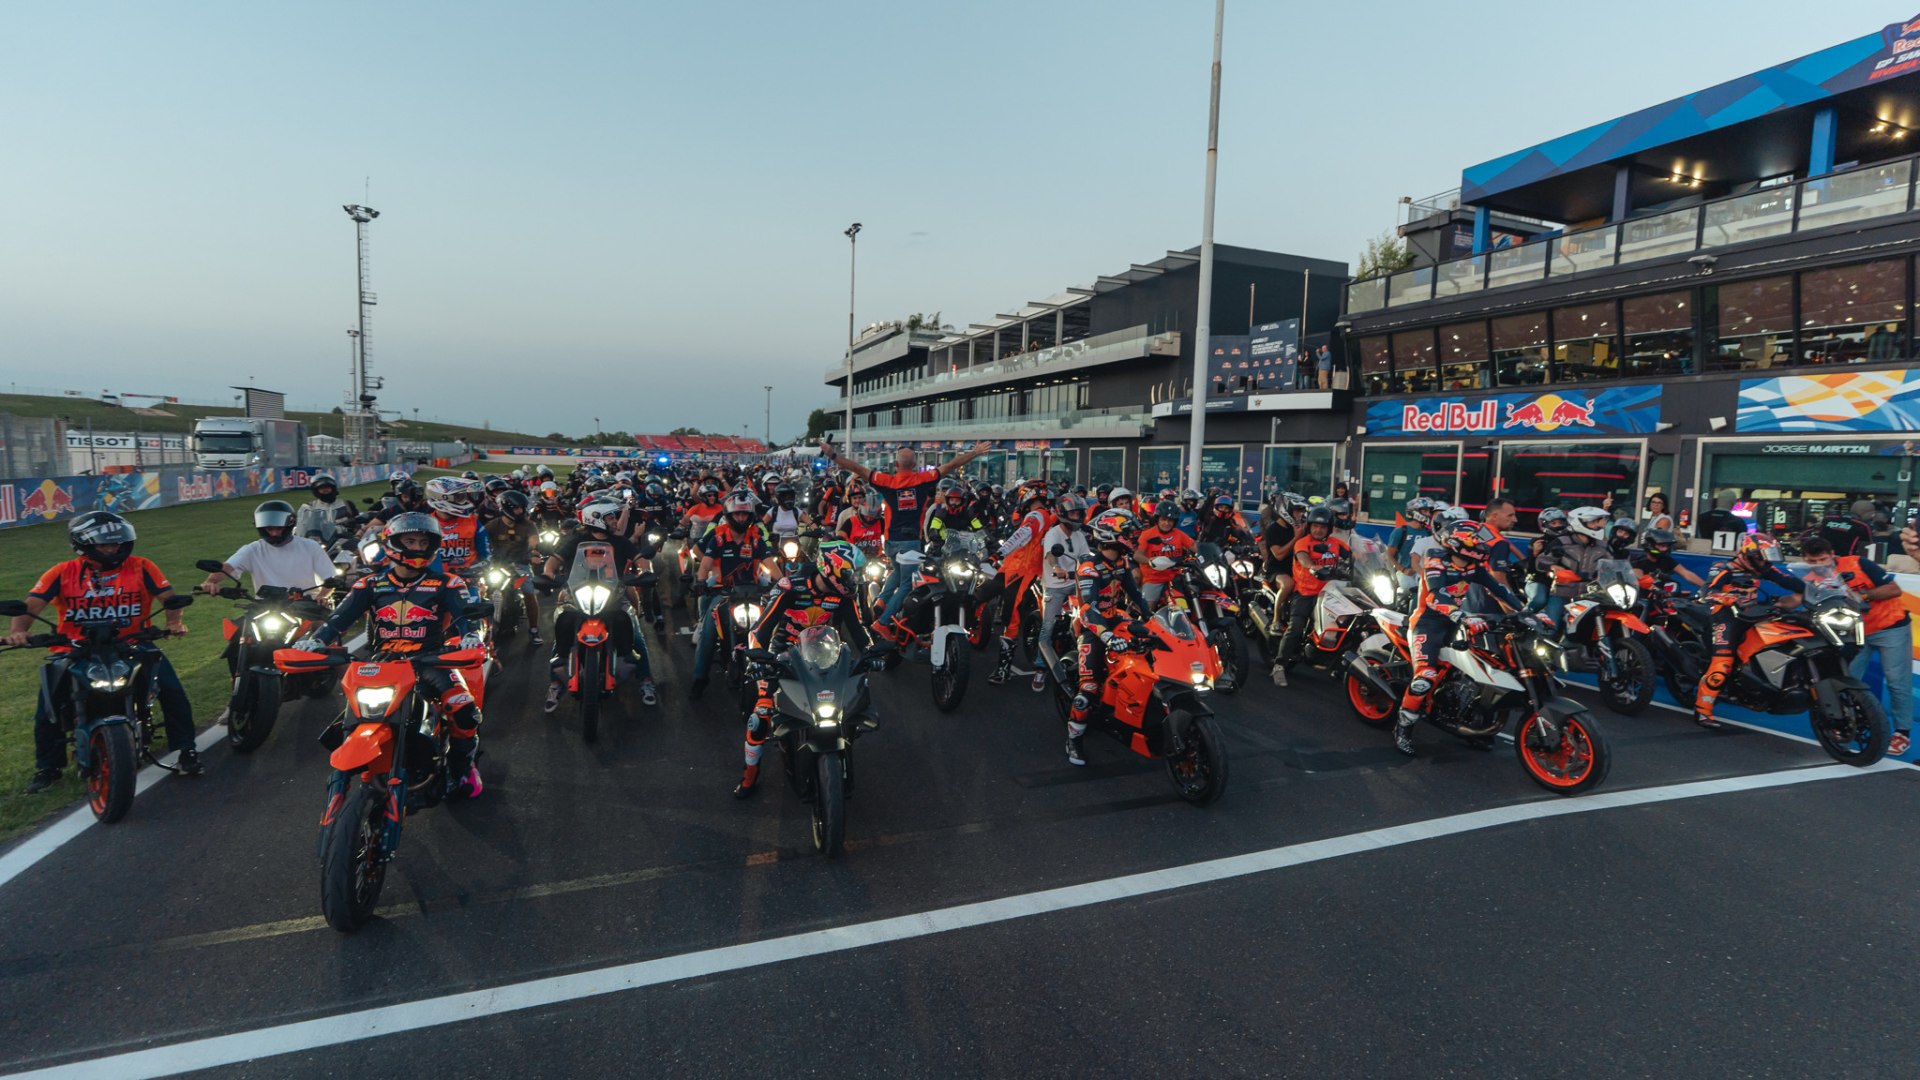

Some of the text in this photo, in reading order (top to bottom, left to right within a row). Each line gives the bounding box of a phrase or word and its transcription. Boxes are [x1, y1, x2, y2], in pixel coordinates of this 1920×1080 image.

[1402, 400, 1498, 431] Red Bull
[67, 437, 130, 448] TISSOT
[1762, 445, 1870, 454] JORGE MARTIN
[1719, 533, 1728, 549] 1
[438, 547, 471, 558] RADE
[64, 604, 141, 621] PARADE
[379, 626, 427, 639] Red Bull
